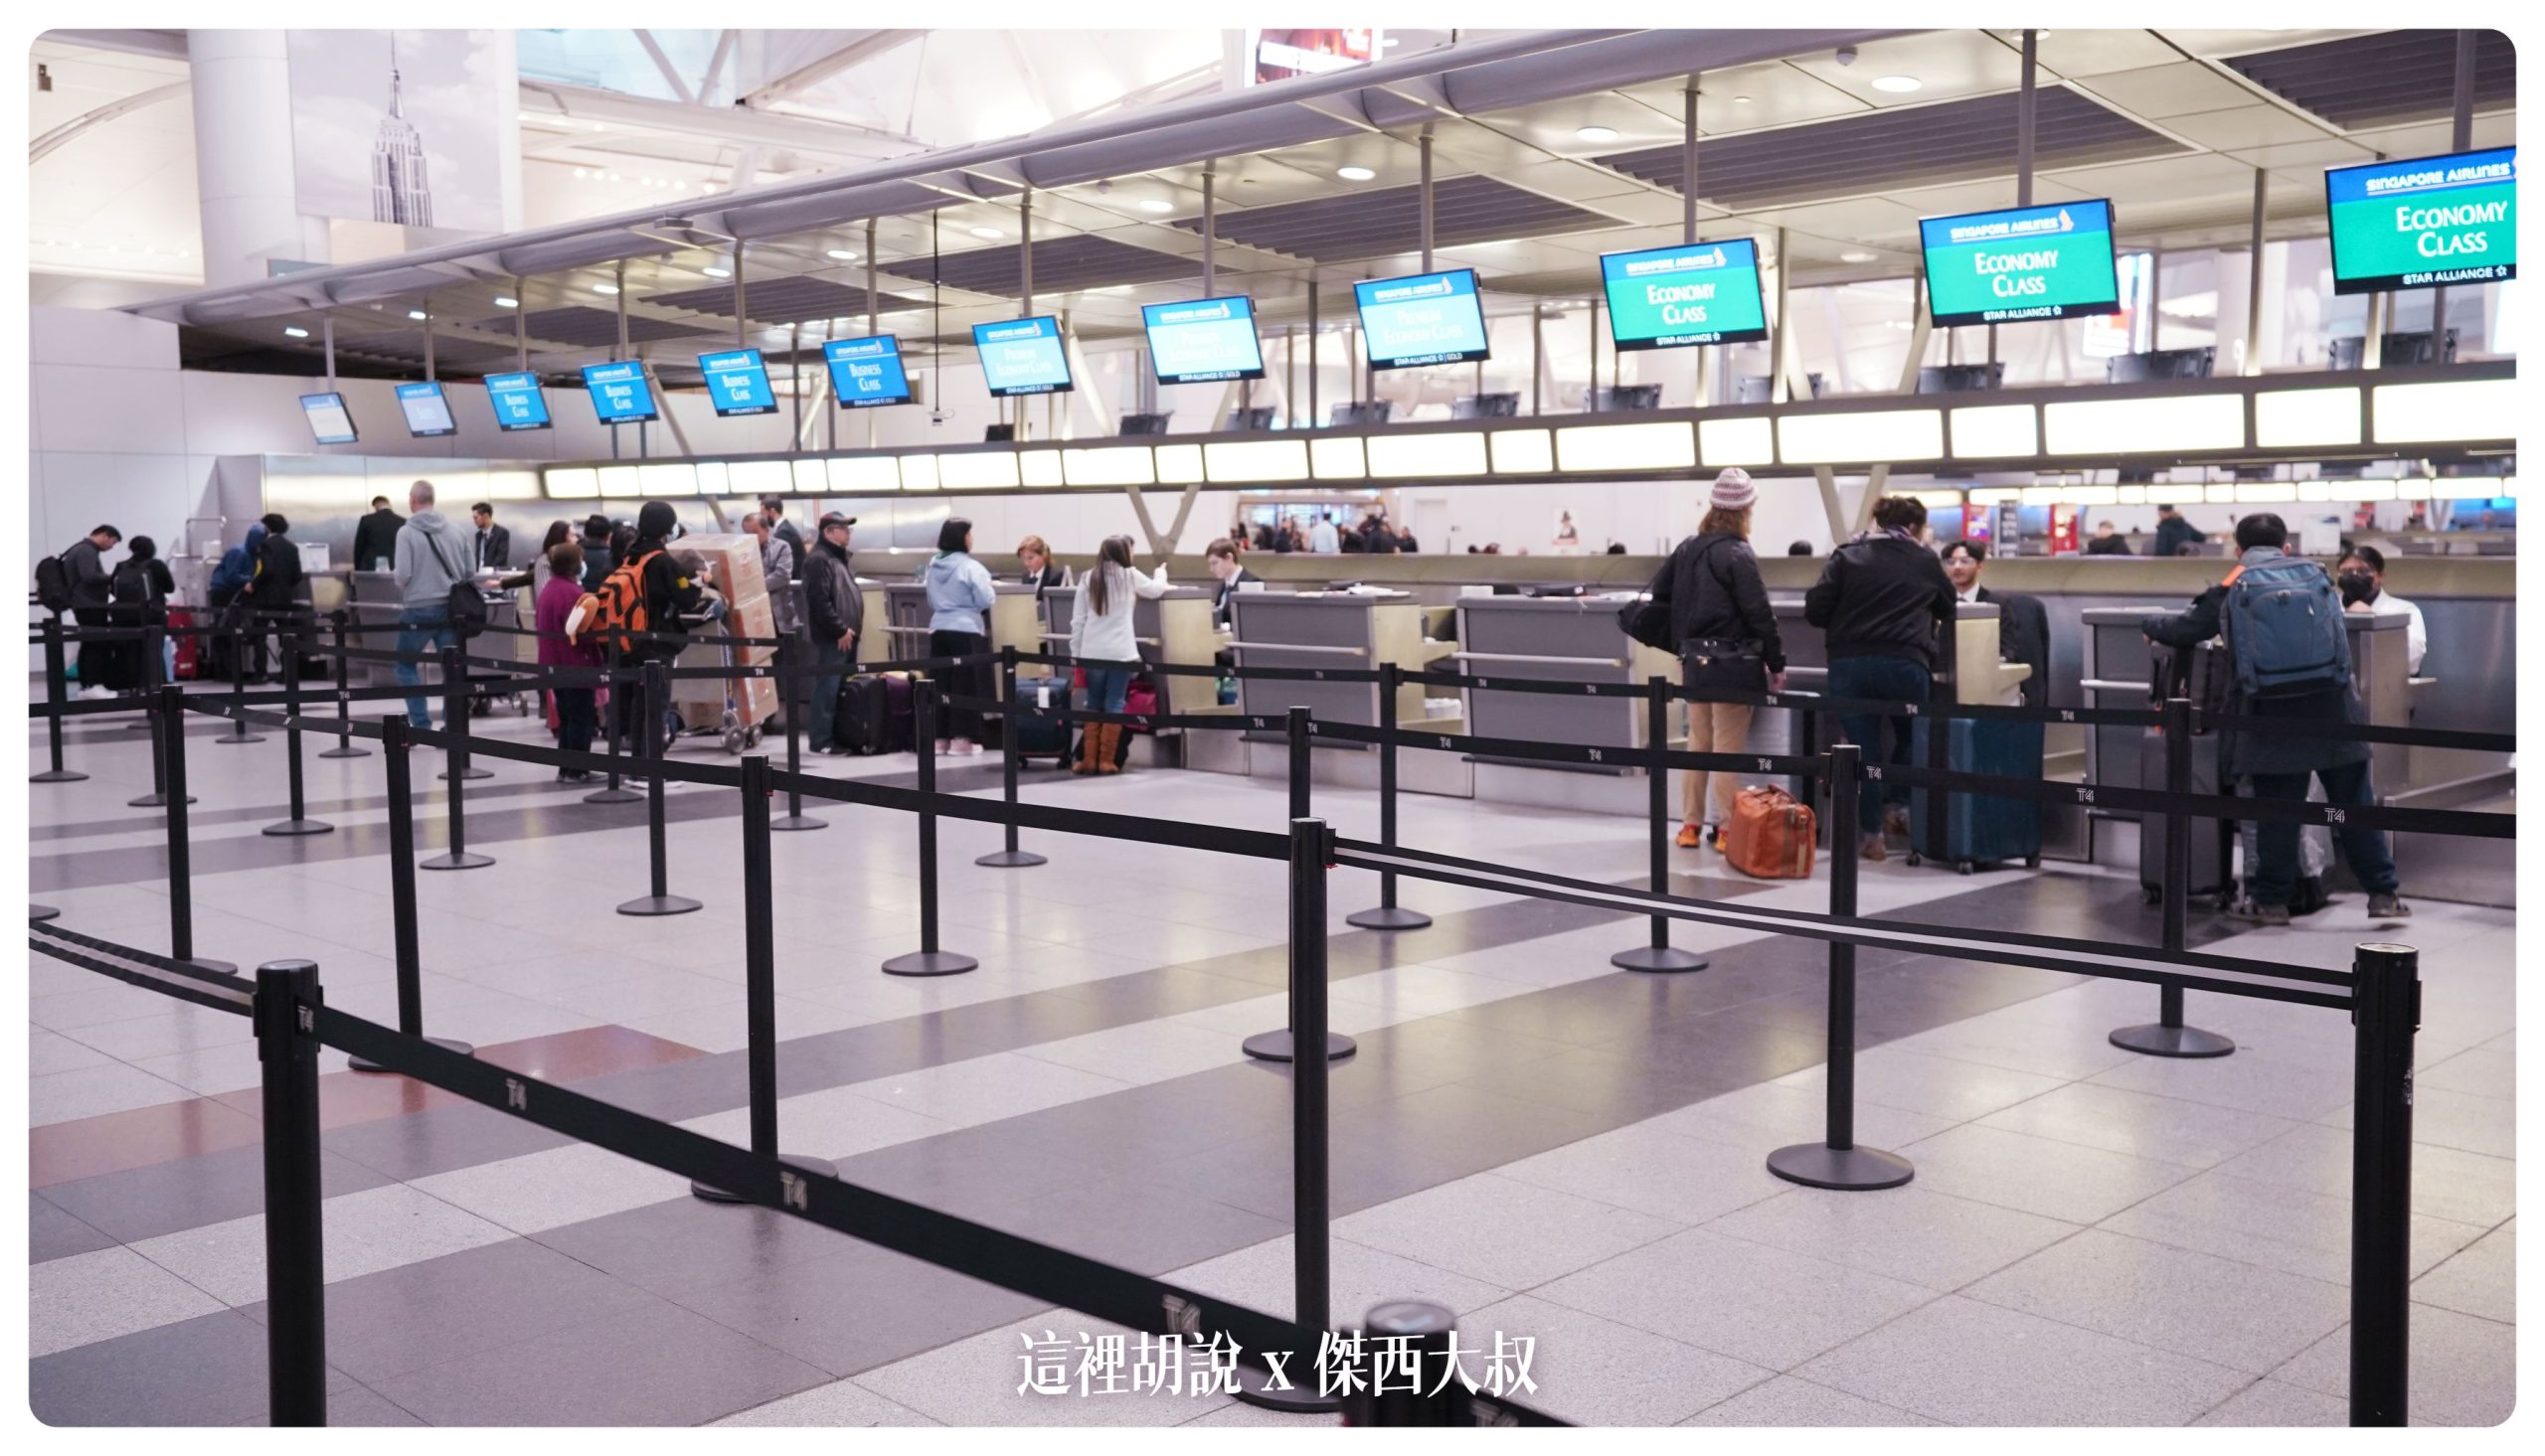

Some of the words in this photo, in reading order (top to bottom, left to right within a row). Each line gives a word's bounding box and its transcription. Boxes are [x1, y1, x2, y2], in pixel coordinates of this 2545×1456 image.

[2366, 170, 2444, 192] SINGAPORE
[2447, 162, 2511, 183] AIRLINES
[2396, 200, 2508, 233] ECONOMY
[2417, 232, 2488, 258] CLASS
[1973, 249, 2059, 275] ECONOMY
[2403, 271, 2433, 285] STAR
[2435, 266, 2493, 282] ALLIANCE
[1646, 282, 1717, 305] ECONOMY
[1992, 274, 2046, 297] CLASS
[1662, 305, 1707, 325] CLASS
[1983, 310, 2006, 321] STAR
[2008, 306, 2052, 319] ALLIANCE
[849, 363, 882, 378] BUSINESS
[859, 378, 882, 392] CLASS
[1766, 695, 1778, 705] T4
[1906, 704, 1919, 715] T4
[2061, 710, 2075, 721] T4
[1440, 736, 1451, 748] T4
[1589, 748, 1602, 761] T4
[1758, 757, 1773, 771] T4
[1866, 765, 1882, 780] T4
[2076, 787, 2095, 803] T4
[2324, 807, 2345, 824] T4
[298, 1005, 314, 1033] T4
[505, 1077, 527, 1111] T4
[779, 1171, 807, 1211] T4
